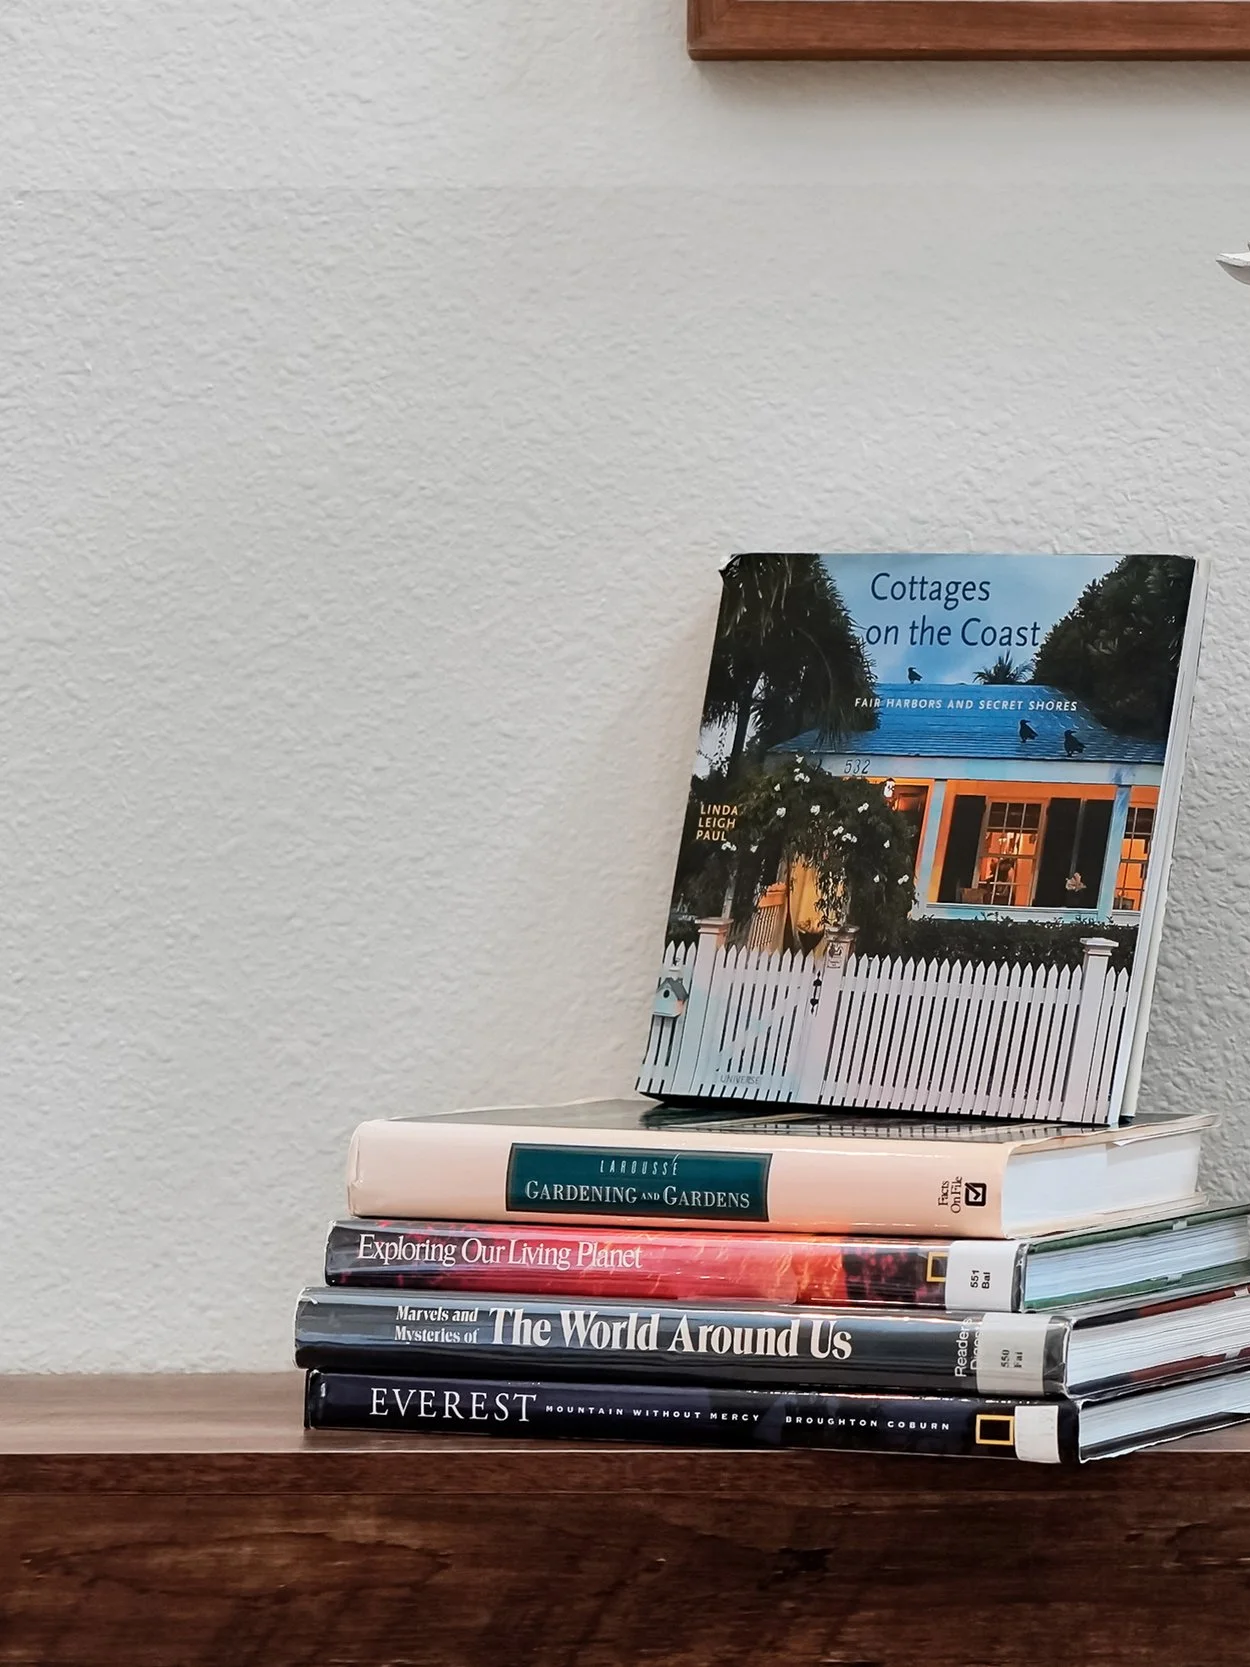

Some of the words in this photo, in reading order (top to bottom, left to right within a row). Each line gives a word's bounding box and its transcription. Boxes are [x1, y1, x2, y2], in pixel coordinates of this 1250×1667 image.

[870, 572, 991, 611] Cottages
[865, 625, 899, 646] on
[909, 615, 952, 646] the
[960, 617, 1041, 647] Coast
[854, 697, 881, 708] FAIR
[886, 698, 942, 710] HARBORS
[947, 699, 974, 710] AND
[978, 700, 1024, 711] SECRET
[1028, 700, 1078, 712] SHORES
[844, 759, 871, 775] 532
[700, 804, 738, 816] LINDA
[698, 816, 736, 829] LEIGH
[695, 829, 727, 841] PAUL
[524, 1180, 638, 1204] GARDENING
[641, 1192, 660, 1201] AND
[662, 1185, 751, 1209] GARDENS
[938, 1180, 949, 1206] Facts
[951, 1176, 963, 1195] File
[950, 1196, 961, 1214] On
[357, 1234, 457, 1267] Exploring
[461, 1237, 506, 1264] Our
[508, 1239, 572, 1271] Living
[576, 1241, 644, 1269] Planet
[970, 1270, 980, 1289] 551
[395, 1305, 449, 1322] Marvels
[452, 1307, 479, 1322] and
[394, 1325, 461, 1345] Mysteries
[463, 1327, 480, 1344] of
[488, 1307, 552, 1347] The
[559, 1309, 661, 1350] World
[667, 1313, 800, 1358] Around
[810, 1319, 853, 1360] Us
[369, 1387, 537, 1423] EVEREST
[545, 1404, 624, 1417] MOUNTAIN
[632, 1408, 702, 1420] WITHOUT
[709, 1411, 760, 1422] MERCY
[785, 1415, 878, 1427] BROUGHTON
[887, 1419, 951, 1431] COBURN
